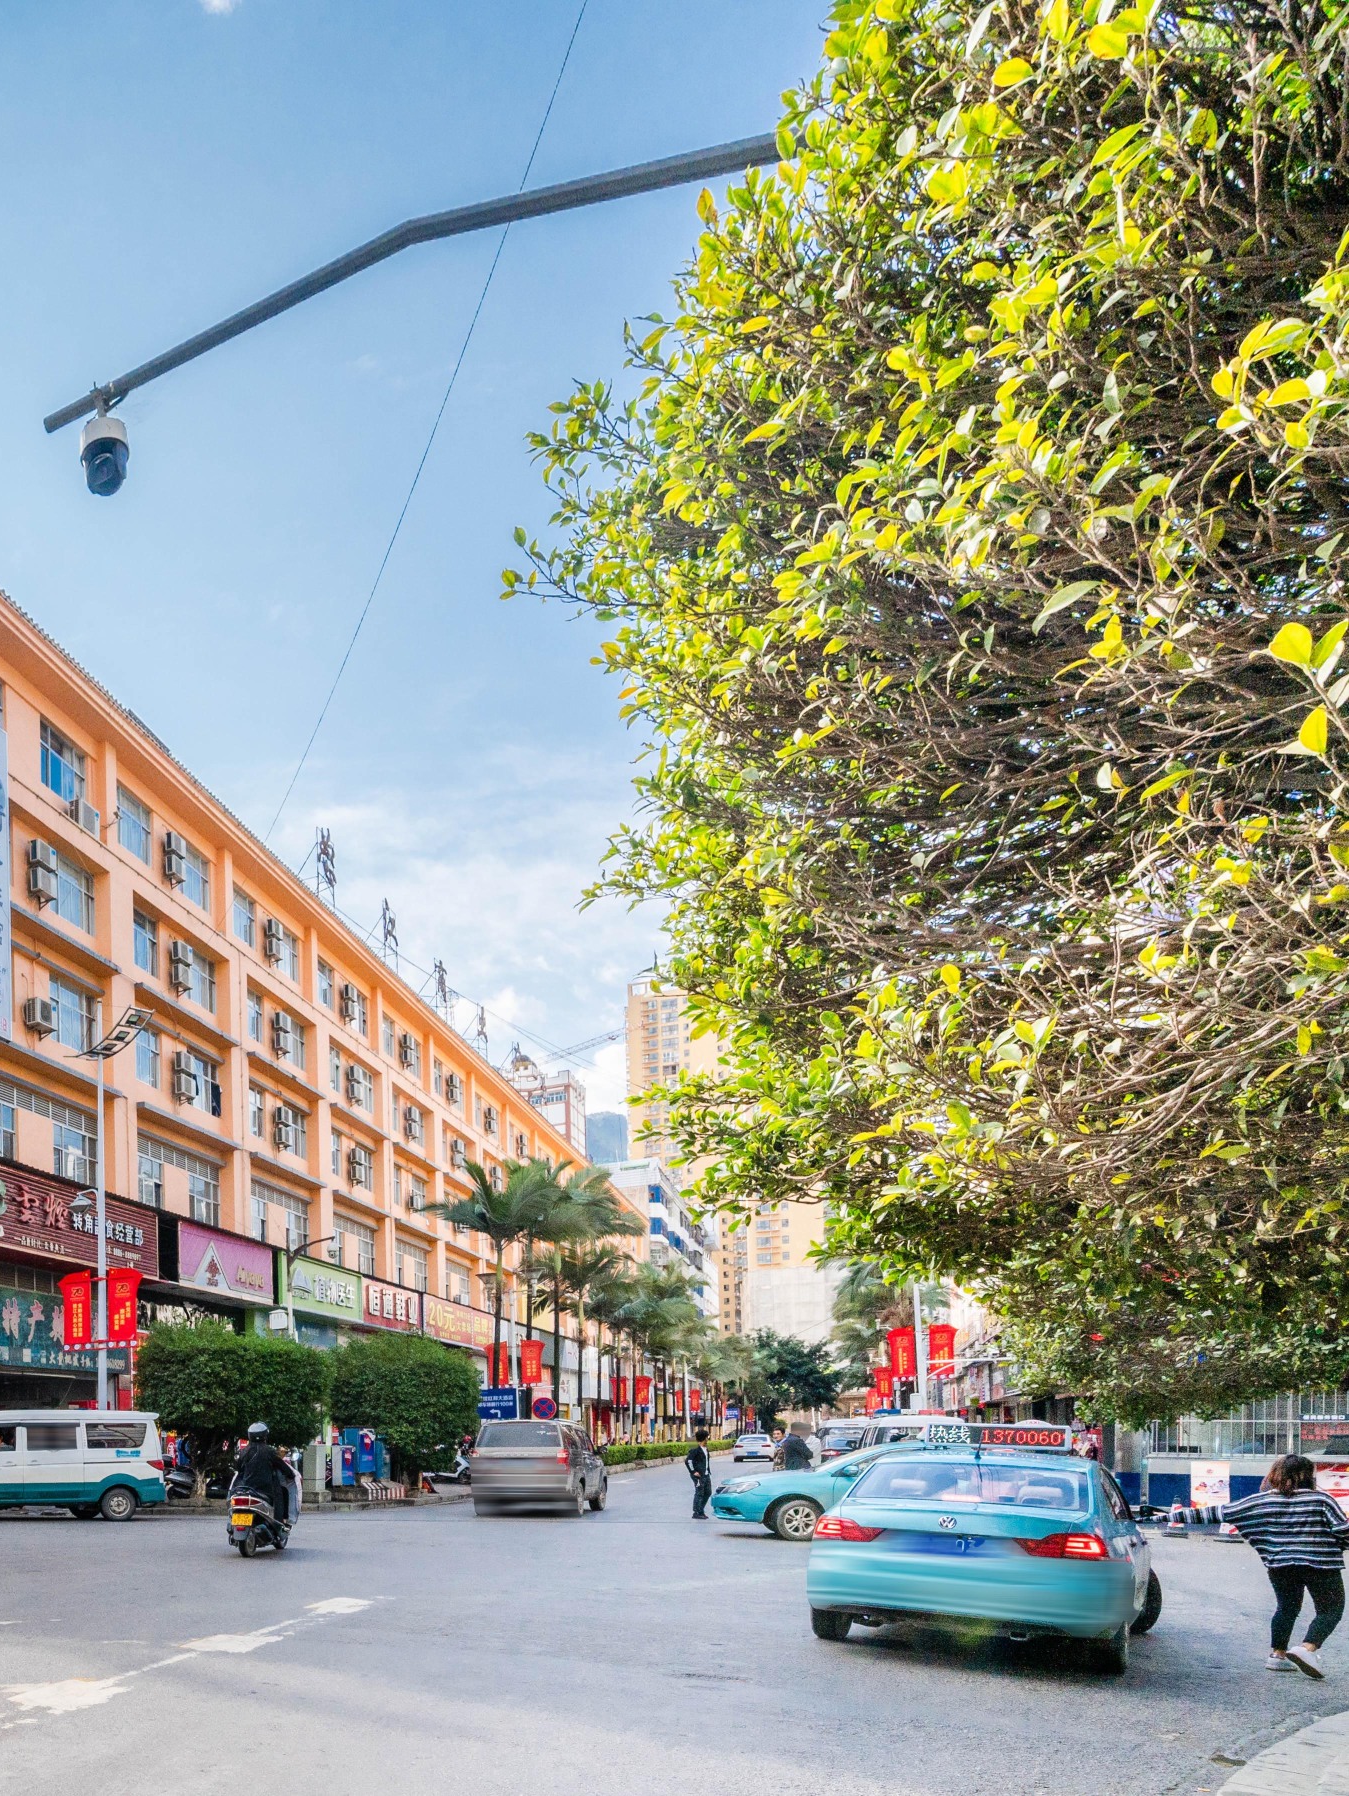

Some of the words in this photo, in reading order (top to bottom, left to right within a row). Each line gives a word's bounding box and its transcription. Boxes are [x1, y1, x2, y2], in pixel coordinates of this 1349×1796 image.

[313, 1274, 355, 1309] 植物医生
[929, 1425, 970, 1444] 热线
[982, 1428, 1066, 1448] 1370060
